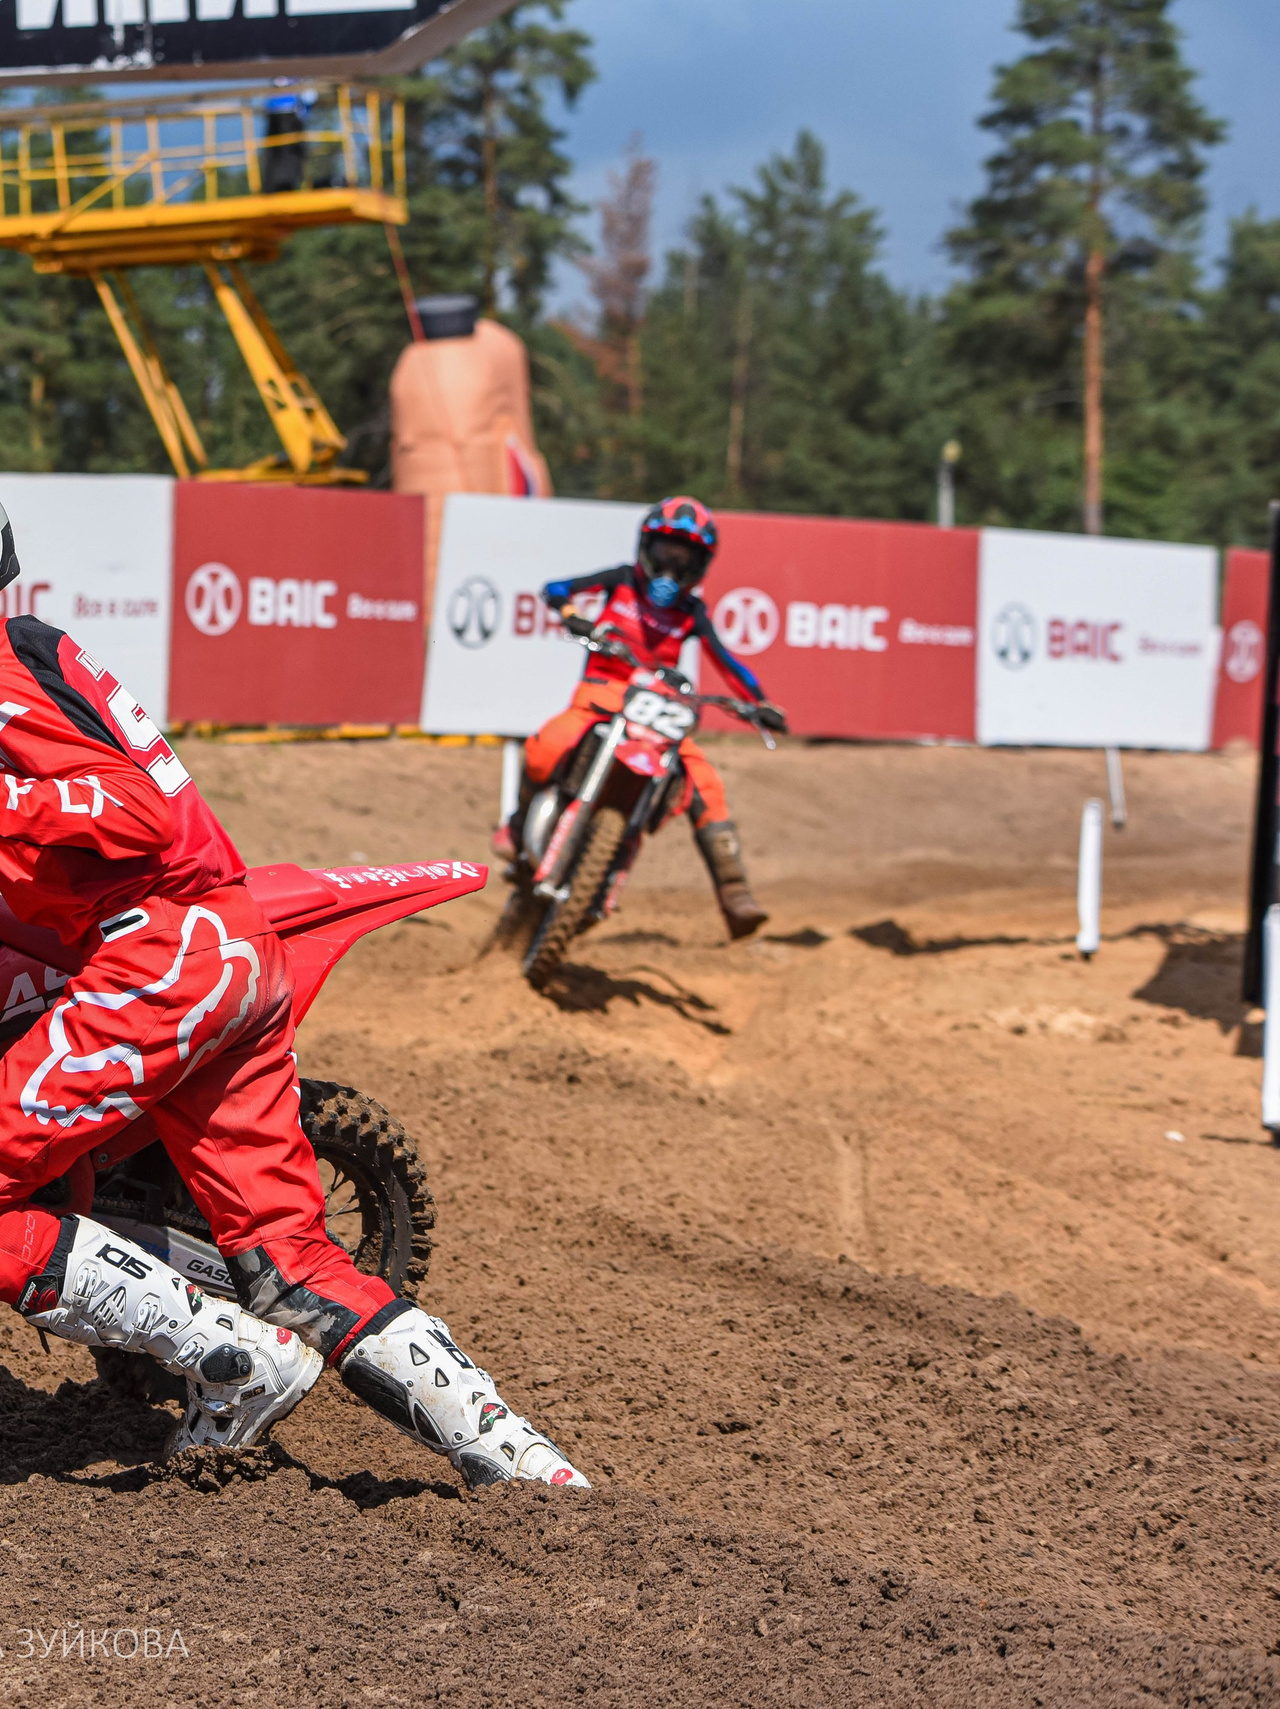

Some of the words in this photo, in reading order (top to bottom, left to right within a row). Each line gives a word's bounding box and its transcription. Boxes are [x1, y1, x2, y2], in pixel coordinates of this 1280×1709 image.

[248, 579, 337, 628] BAIC
[786, 602, 889, 651] BAIC
[1044, 618, 1124, 662] BAIC
[623, 691, 694, 740] 82
